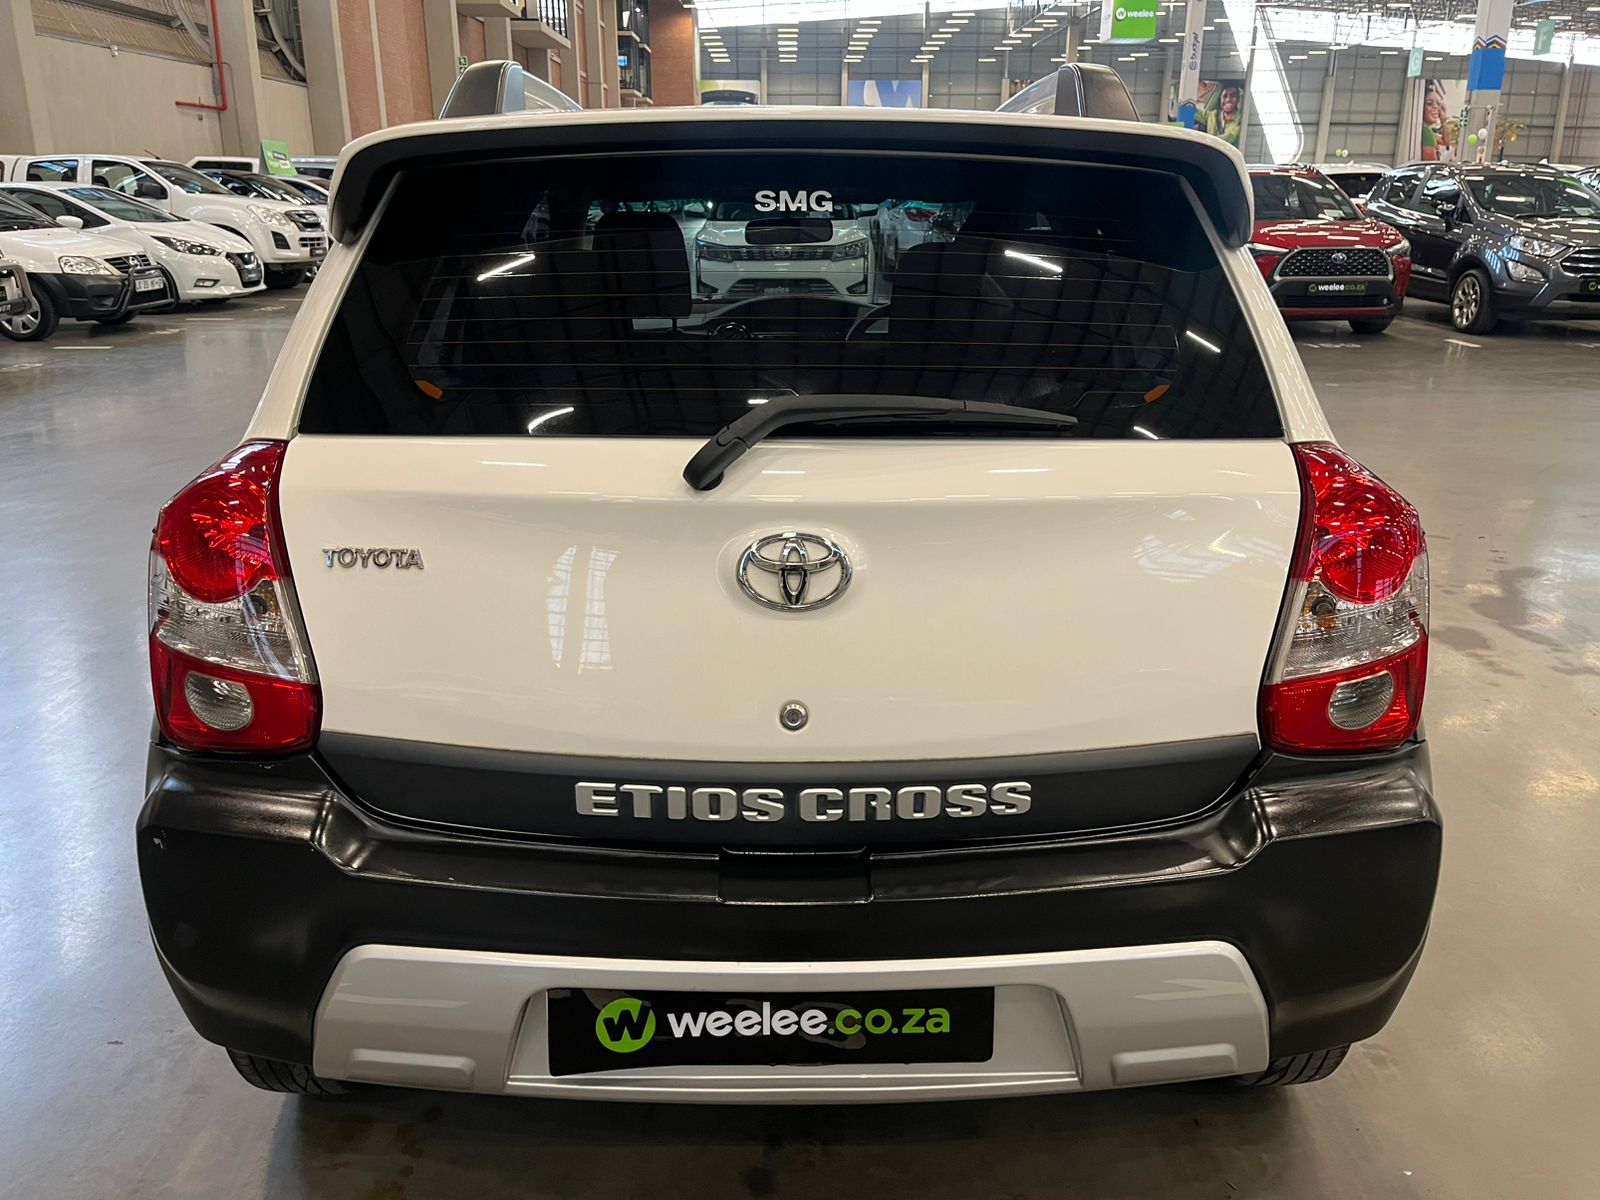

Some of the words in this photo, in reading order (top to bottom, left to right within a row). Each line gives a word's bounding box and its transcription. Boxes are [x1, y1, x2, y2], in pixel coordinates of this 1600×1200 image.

[1127, 9, 1155, 18] weelee
[1537, 26, 1550, 51] F
[754, 190, 833, 213] SMG
[322, 547, 424, 569] TOYOTA
[574, 781, 785, 823] ETIOS
[799, 781, 1032, 823] CROSS
[667, 1001, 951, 1038] weelee.co.za
